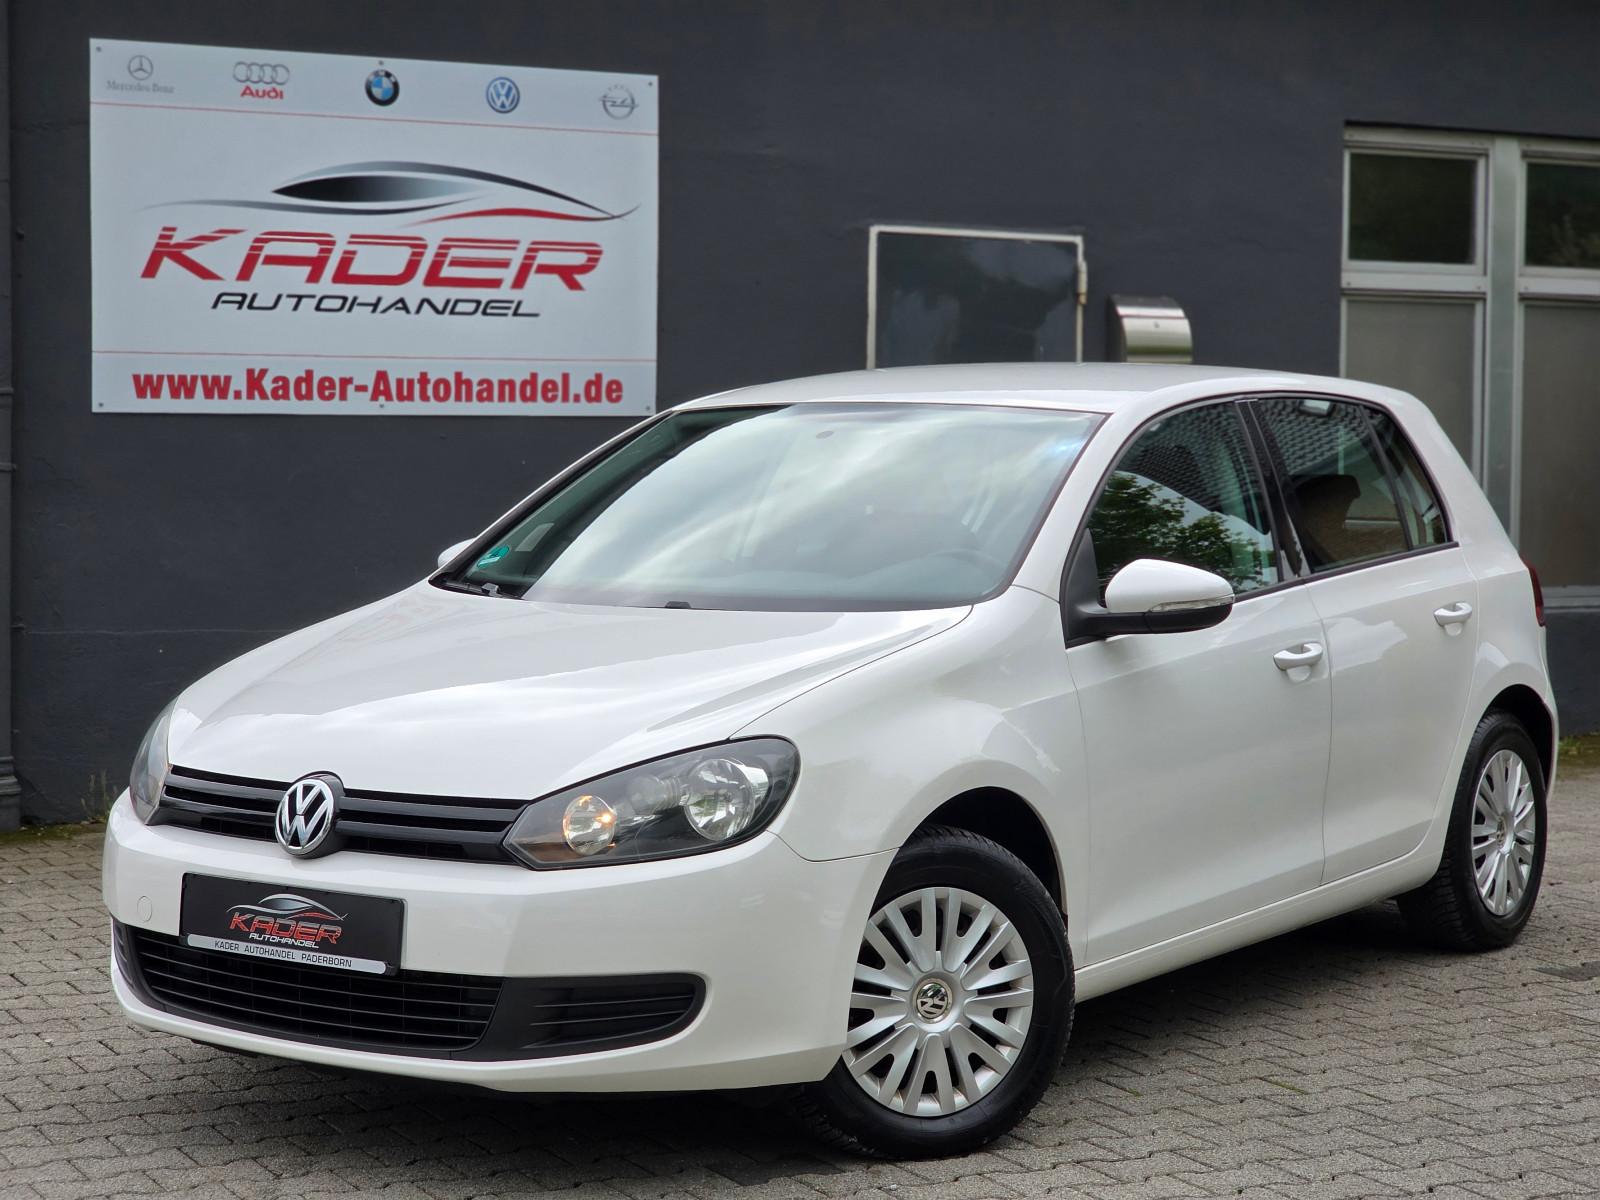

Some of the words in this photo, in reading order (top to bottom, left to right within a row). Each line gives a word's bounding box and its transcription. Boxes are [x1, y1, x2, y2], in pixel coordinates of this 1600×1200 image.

[240, 85, 284, 100] Audi
[140, 226, 604, 291] KADER
[211, 292, 540, 317] AUTOHANDEL
[132, 368, 624, 404] www.Kader-Autohandel.de
[277, 780, 334, 852] VW
[229, 912, 342, 944] KADER
[249, 933, 319, 949] AUTOHANDEL
[214, 940, 239, 952] KADER
[244, 945, 295, 960] AUTOHANDEL
[301, 953, 352, 968] PADERBORN
